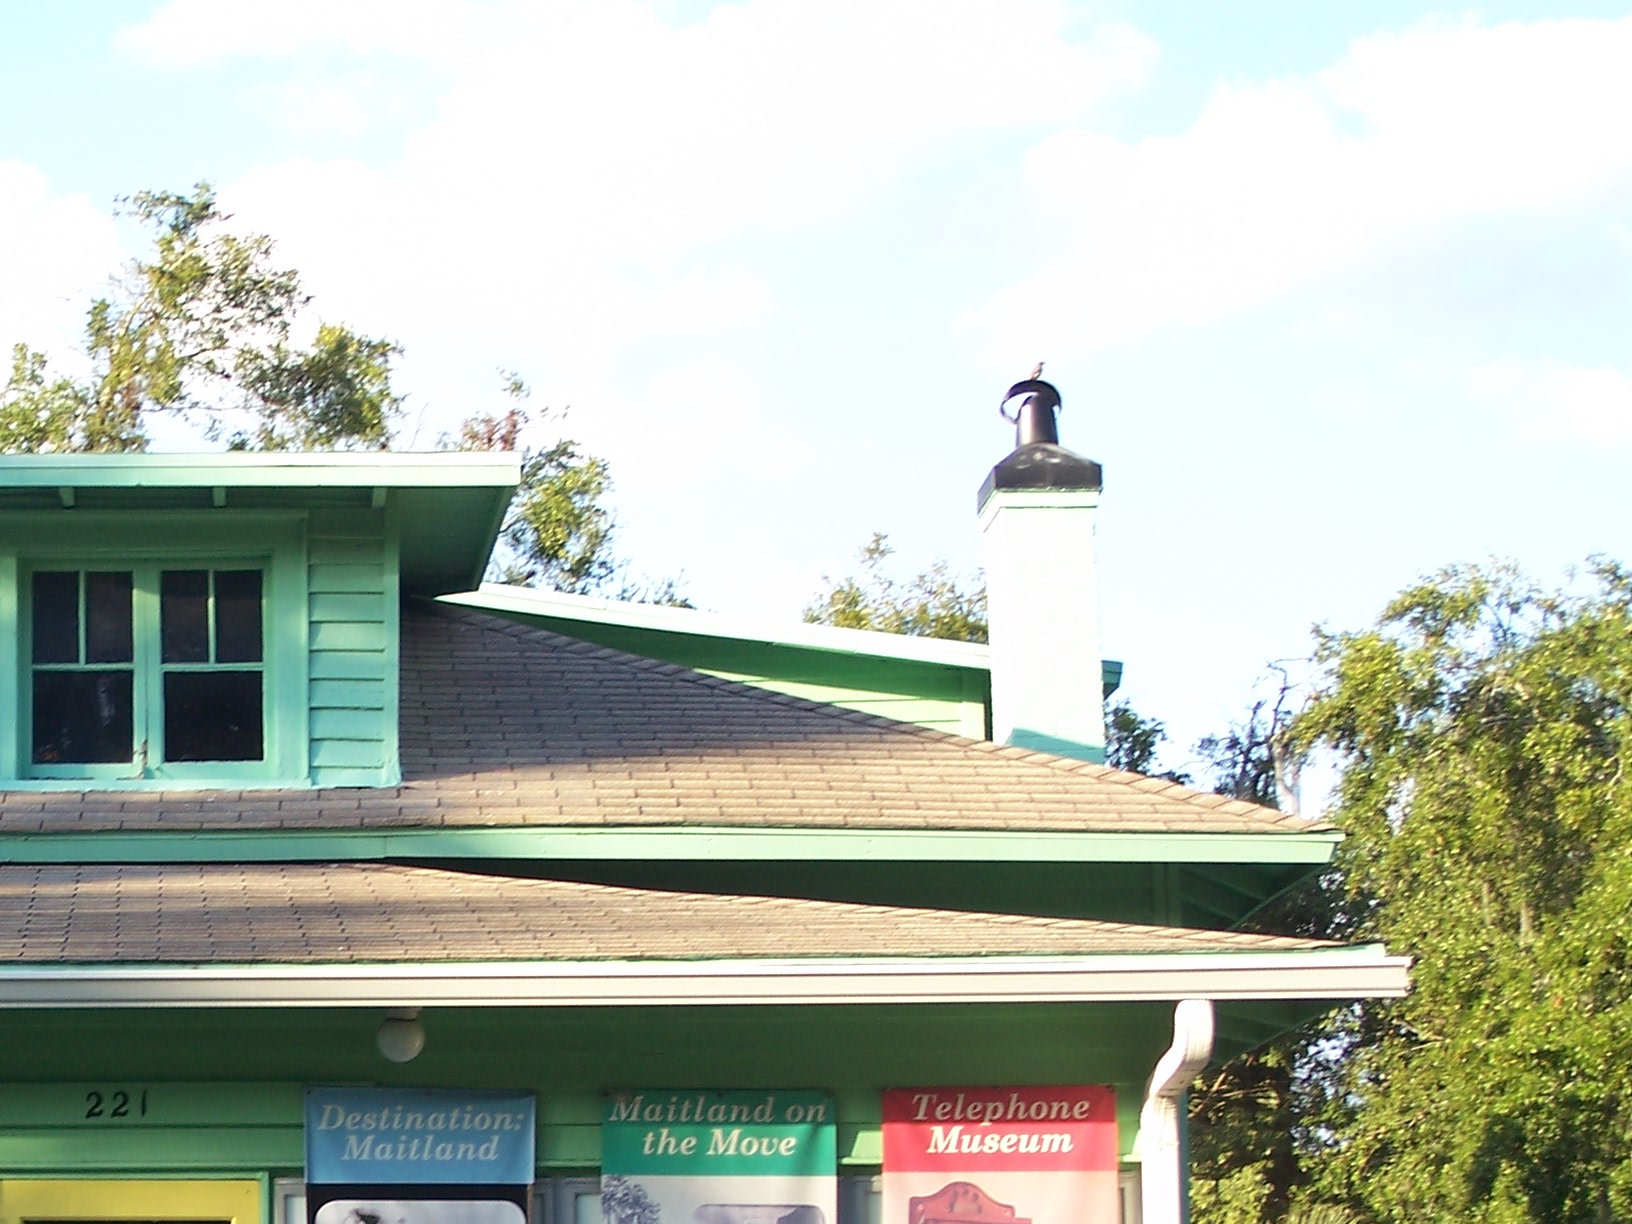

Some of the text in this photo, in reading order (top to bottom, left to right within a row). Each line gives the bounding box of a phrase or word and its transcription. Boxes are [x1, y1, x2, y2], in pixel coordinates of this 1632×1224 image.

[85, 1089, 147, 1119] 221
[318, 1104, 525, 1131] Destination:
[608, 1095, 827, 1123] Maitland on
[912, 1093, 1091, 1126] Telephone
[341, 1135, 500, 1161] Maitland
[642, 1127, 798, 1156] the Move
[926, 1126, 1073, 1154] Museum
